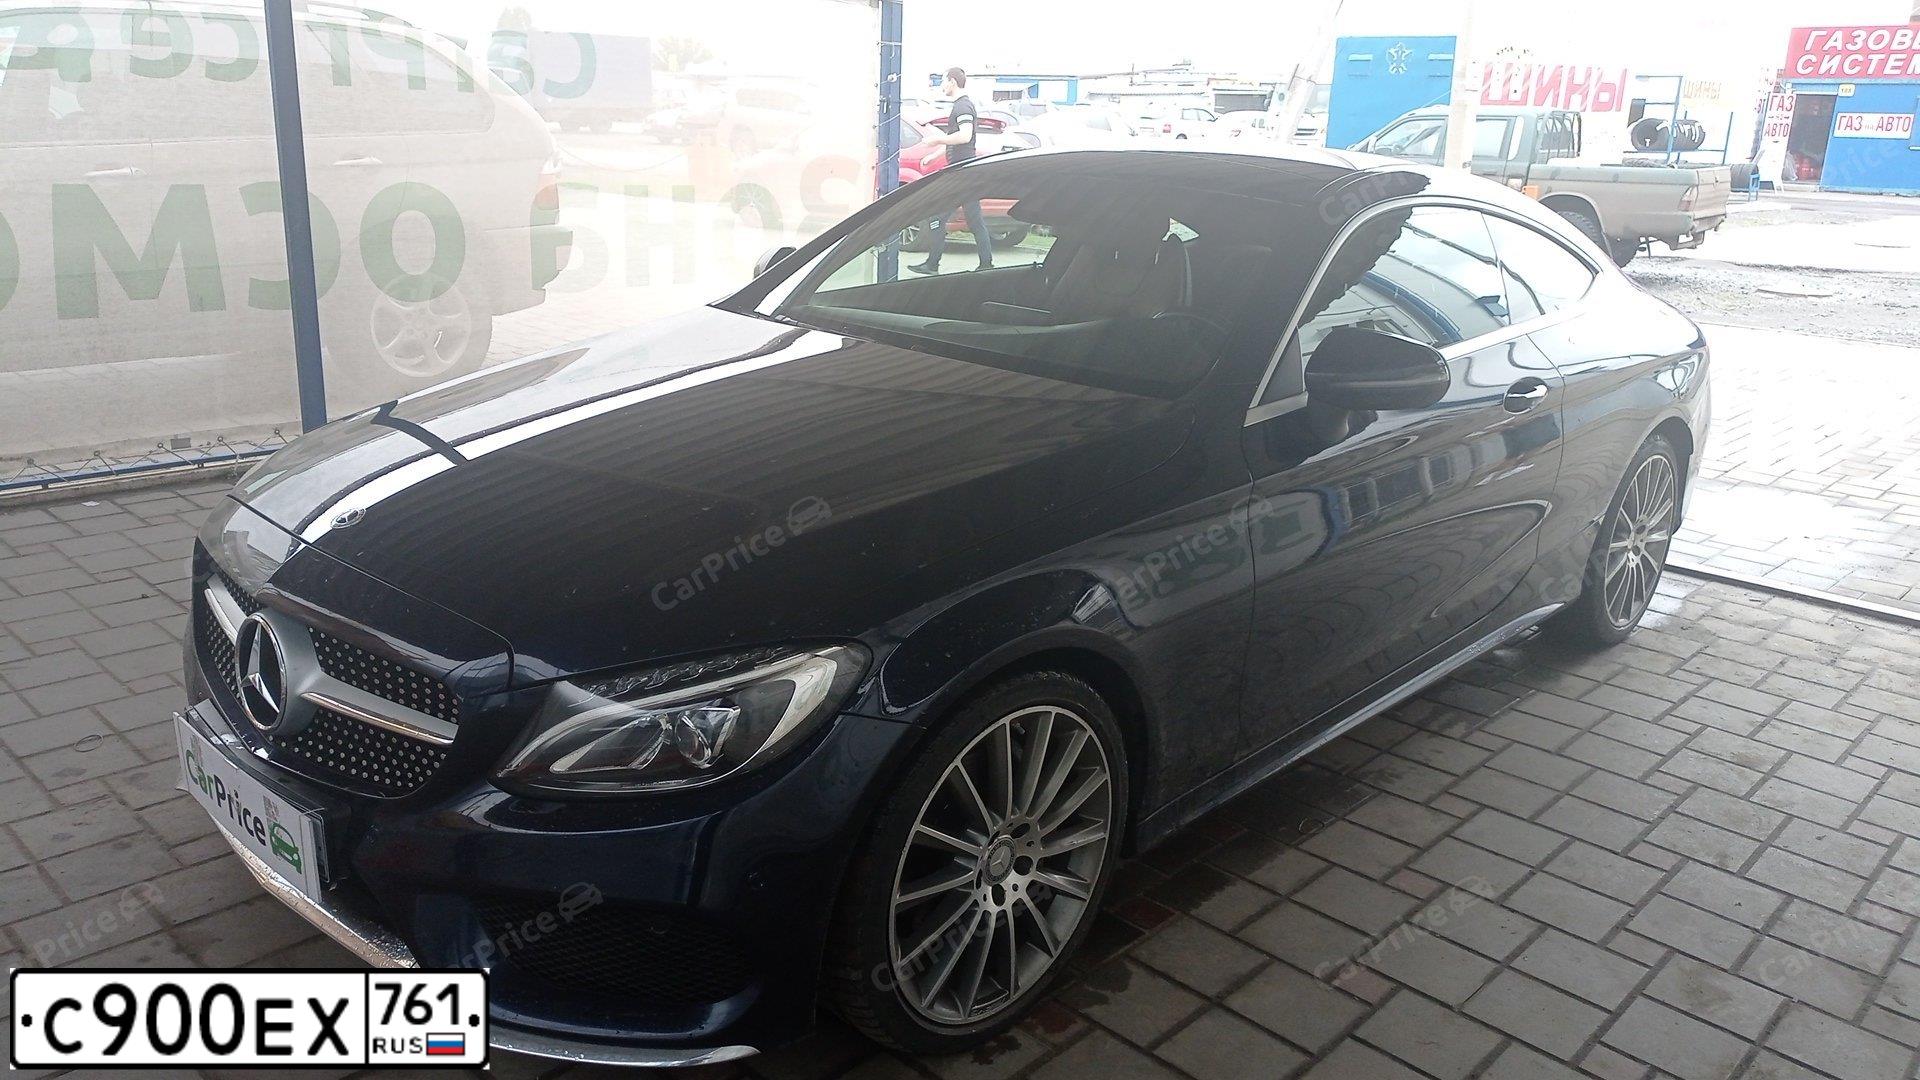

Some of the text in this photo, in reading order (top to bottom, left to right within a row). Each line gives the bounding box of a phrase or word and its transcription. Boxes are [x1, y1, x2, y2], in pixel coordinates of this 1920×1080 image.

[1479, 63, 1628, 113] ШИНЫ
[1769, 95, 1795, 112] ГАЗ
[1764, 123, 1789, 137] АВТО
[1838, 115, 1863, 131] ГАЗ
[1876, 116, 1911, 132] АВТО
[186, 749, 267, 846] CarPrice
